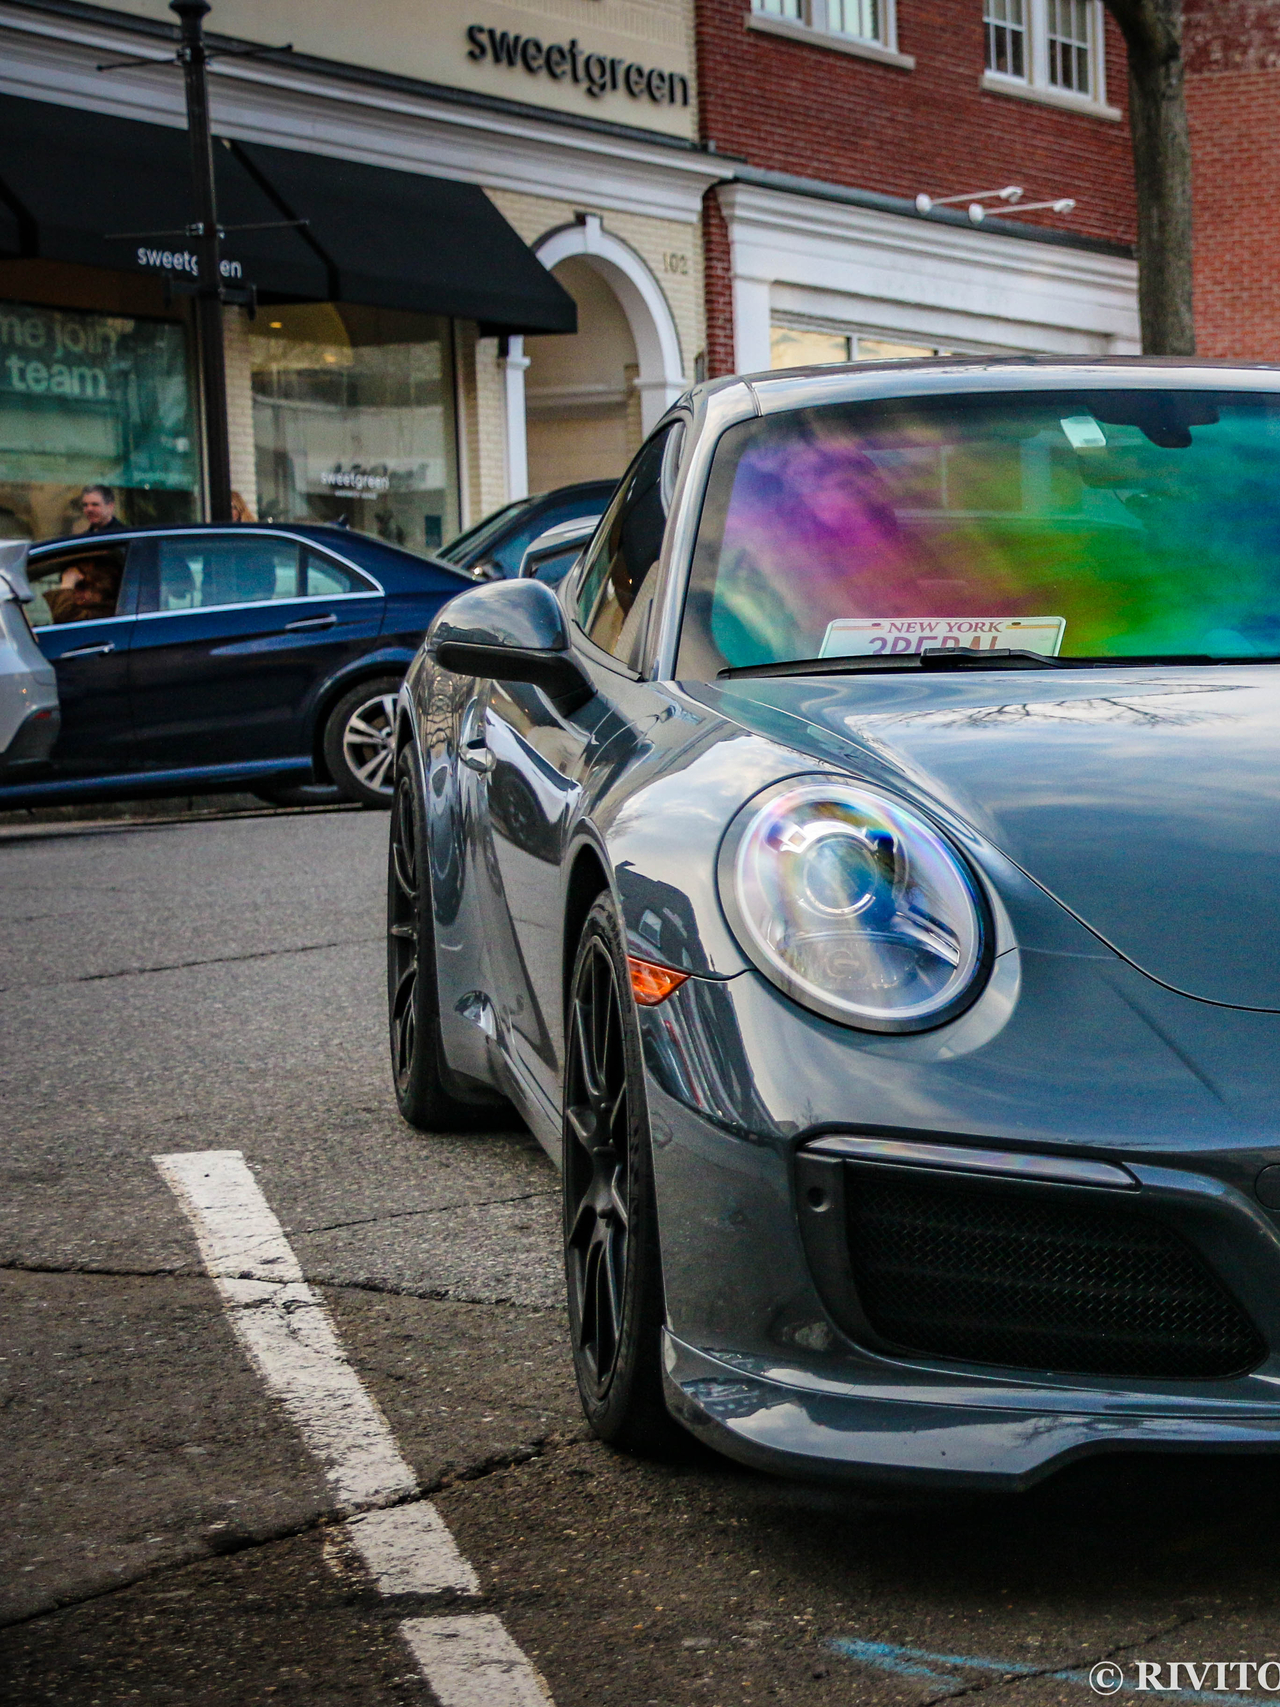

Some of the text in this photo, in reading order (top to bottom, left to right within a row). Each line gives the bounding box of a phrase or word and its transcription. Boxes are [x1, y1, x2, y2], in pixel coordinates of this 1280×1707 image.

[466, 24, 689, 106] sweetgreen
[137, 247, 242, 279] sweetgen
[5, 354, 107, 399] team
[887, 621, 1004, 634] NEW YORK
